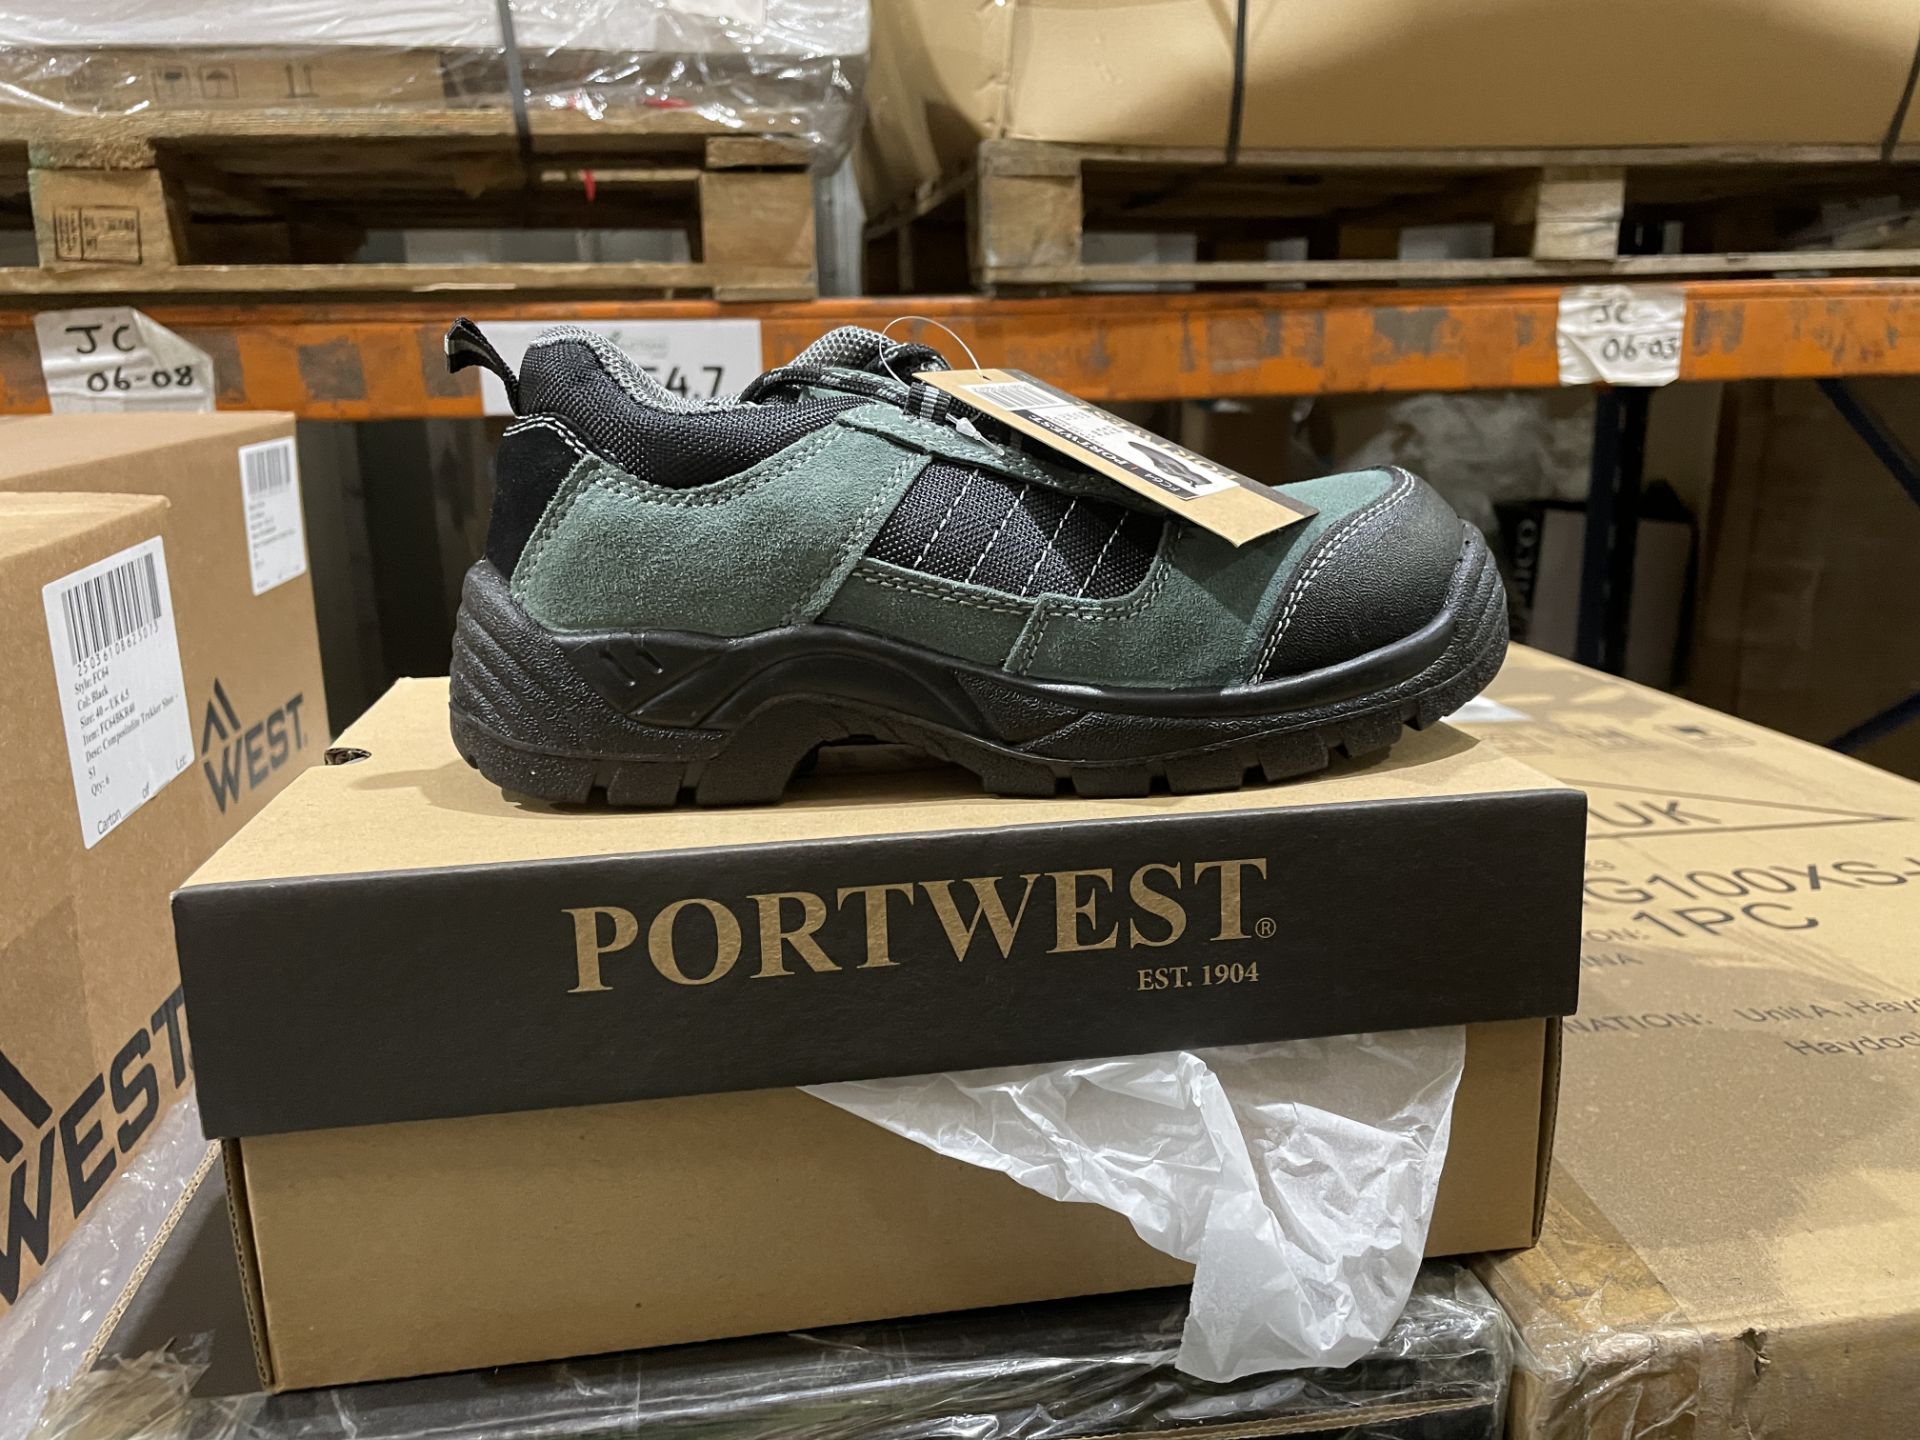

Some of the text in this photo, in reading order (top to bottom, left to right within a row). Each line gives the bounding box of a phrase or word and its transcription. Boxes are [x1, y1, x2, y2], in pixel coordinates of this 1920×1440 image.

[87, 365, 193, 392] 06-08
[91, 684, 108, 703] Black
[97, 809, 121, 835] Carton
[1633, 902, 1819, 937] 1PC
[1138, 961, 1259, 991] EST. 1904
